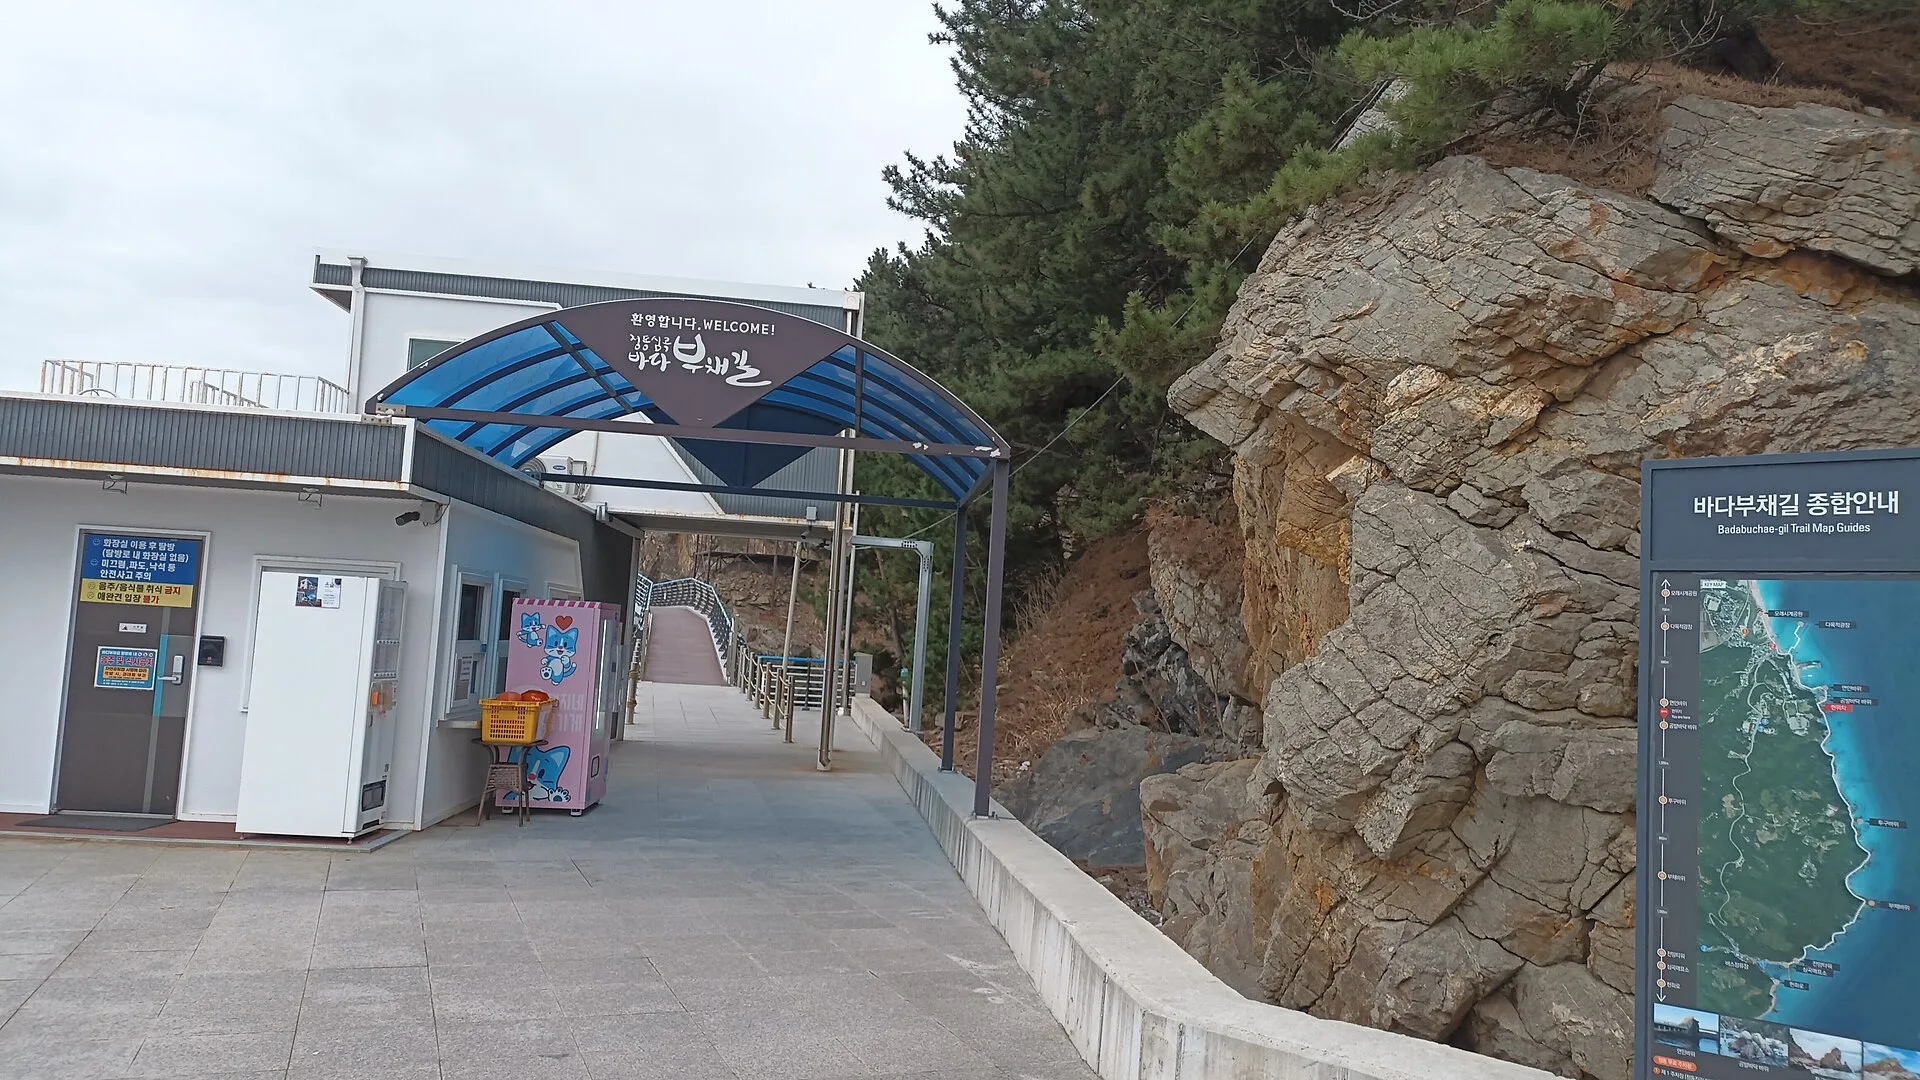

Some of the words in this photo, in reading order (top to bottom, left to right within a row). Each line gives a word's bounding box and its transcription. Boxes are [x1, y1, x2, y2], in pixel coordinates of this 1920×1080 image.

[1693, 493, 1800, 518] 바다부채길
[1806, 490, 1900, 516] 종합안내
[1717, 524, 1789, 536] Badabuchae-gil
[1790, 522, 1811, 534] Trail
[1812, 523, 1835, 535] Map
[1836, 521, 1871, 533] Guides
[103, 538, 128, 548] 화장실
[130, 540, 147, 549] 이용
[149, 541, 157, 550] 후
[158, 542, 175, 552] 탐방
[102, 548, 131, 559] (탐방로
[132, 550, 140, 560] 내
[142, 551, 167, 561] 화장실
[169, 553, 189, 563] 없음)
[167, 563, 176, 572] 등
[100, 570, 133, 580] 안전사고
[135, 571, 152, 581] 주의
[98, 582, 145, 593] 음주/음식물
[146, 584, 163, 594] 취식
[164, 585, 181, 595] 금지
[97, 592, 122, 602] 애완견
[124, 593, 141, 603] 입장
[143, 595, 160, 604] 불가
